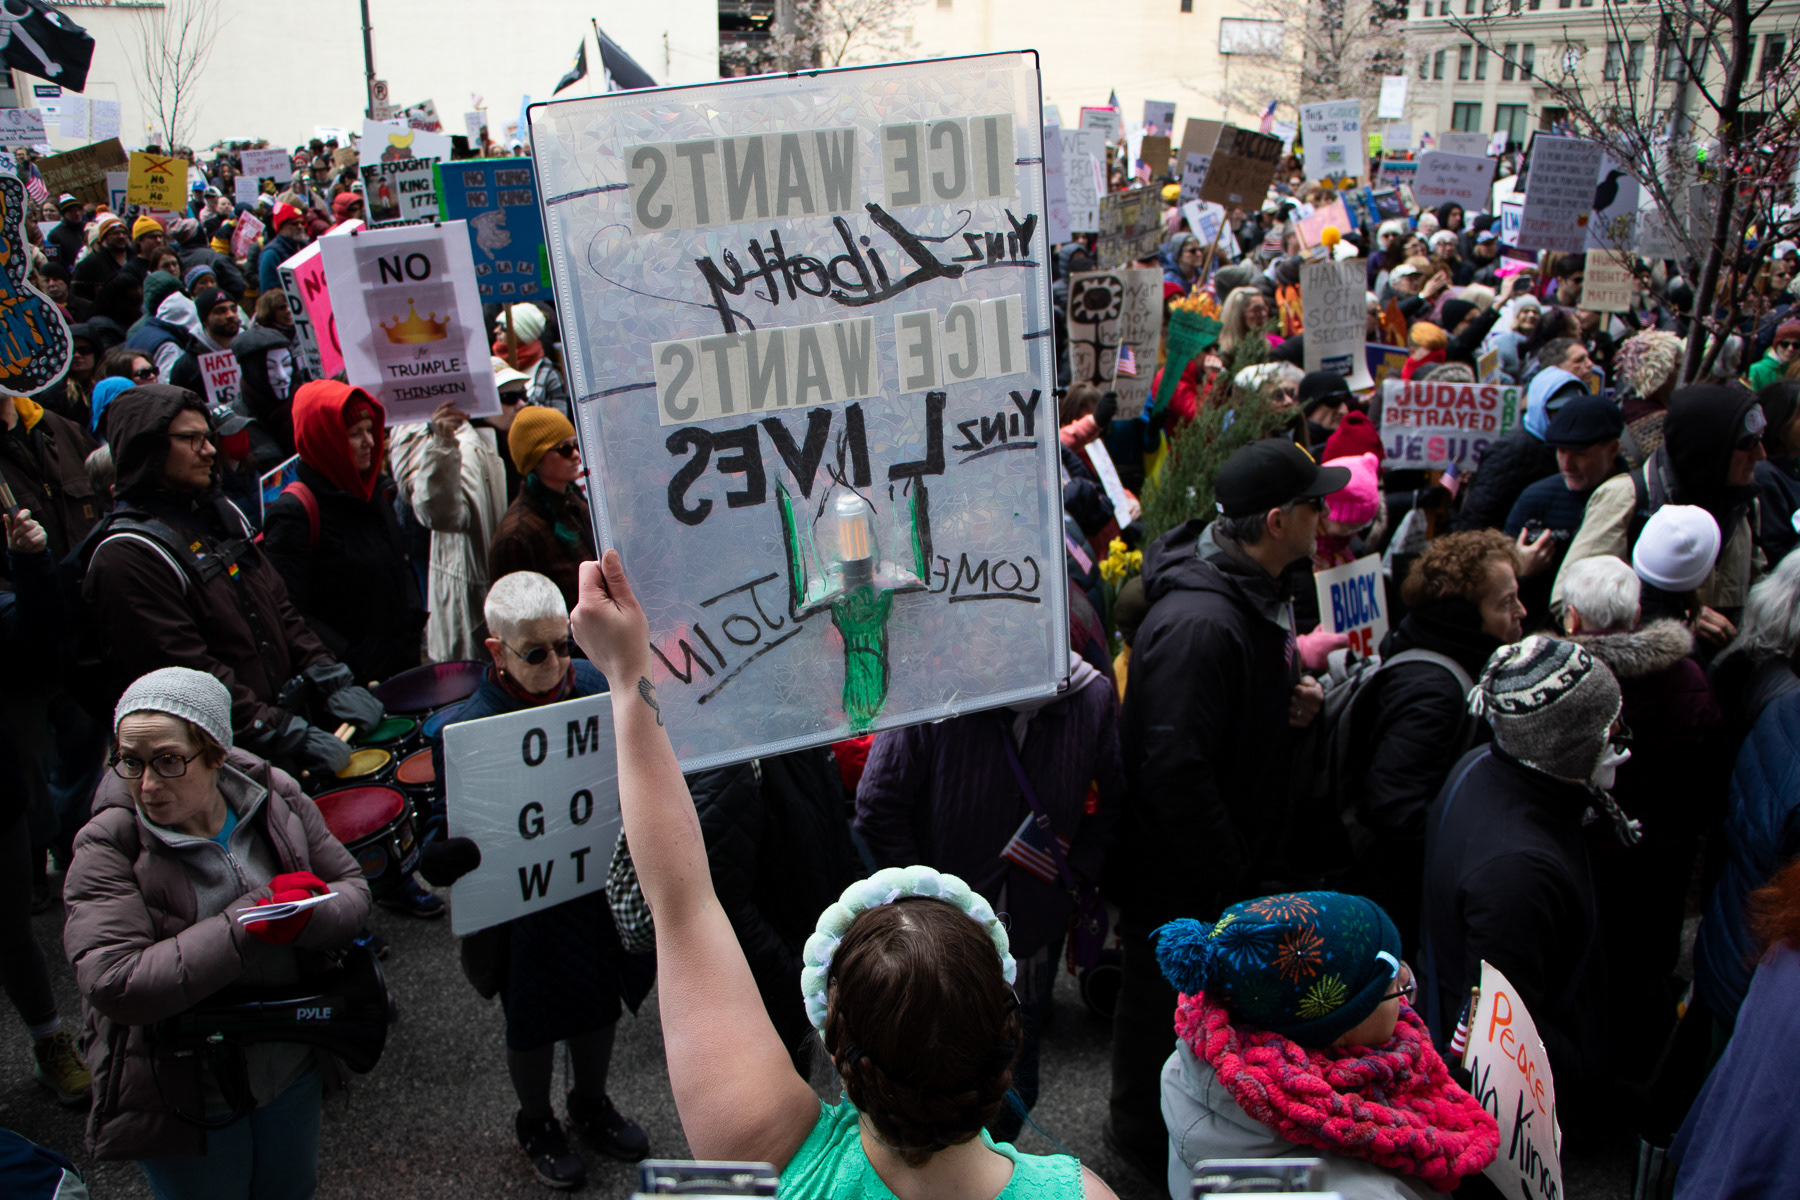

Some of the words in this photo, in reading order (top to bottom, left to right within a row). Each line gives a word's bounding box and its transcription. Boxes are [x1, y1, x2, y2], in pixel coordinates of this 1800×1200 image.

[381, 158, 430, 175] FOUGHT
[150, 175, 165, 184] NO
[400, 178, 430, 193] KING
[411, 193, 438, 208] 1775
[378, 253, 432, 284] NO
[498, 261, 512, 272] LA
[518, 262, 533, 273] LA
[1308, 263, 1365, 290] HANDS
[1323, 287, 1351, 306] OFF
[1307, 305, 1366, 328] SOCIAL
[415, 347, 428, 359] for
[211, 370, 237, 387] NOT
[216, 386, 235, 403] US
[393, 382, 466, 400] THINSKIN
[1395, 383, 1499, 411] JUDAS
[1386, 407, 1496, 432] BETRAYED
[1330, 571, 1380, 633] BLOCK
[296, 1007, 332, 1020] PYLE
[1488, 991, 1546, 1115] Peace
